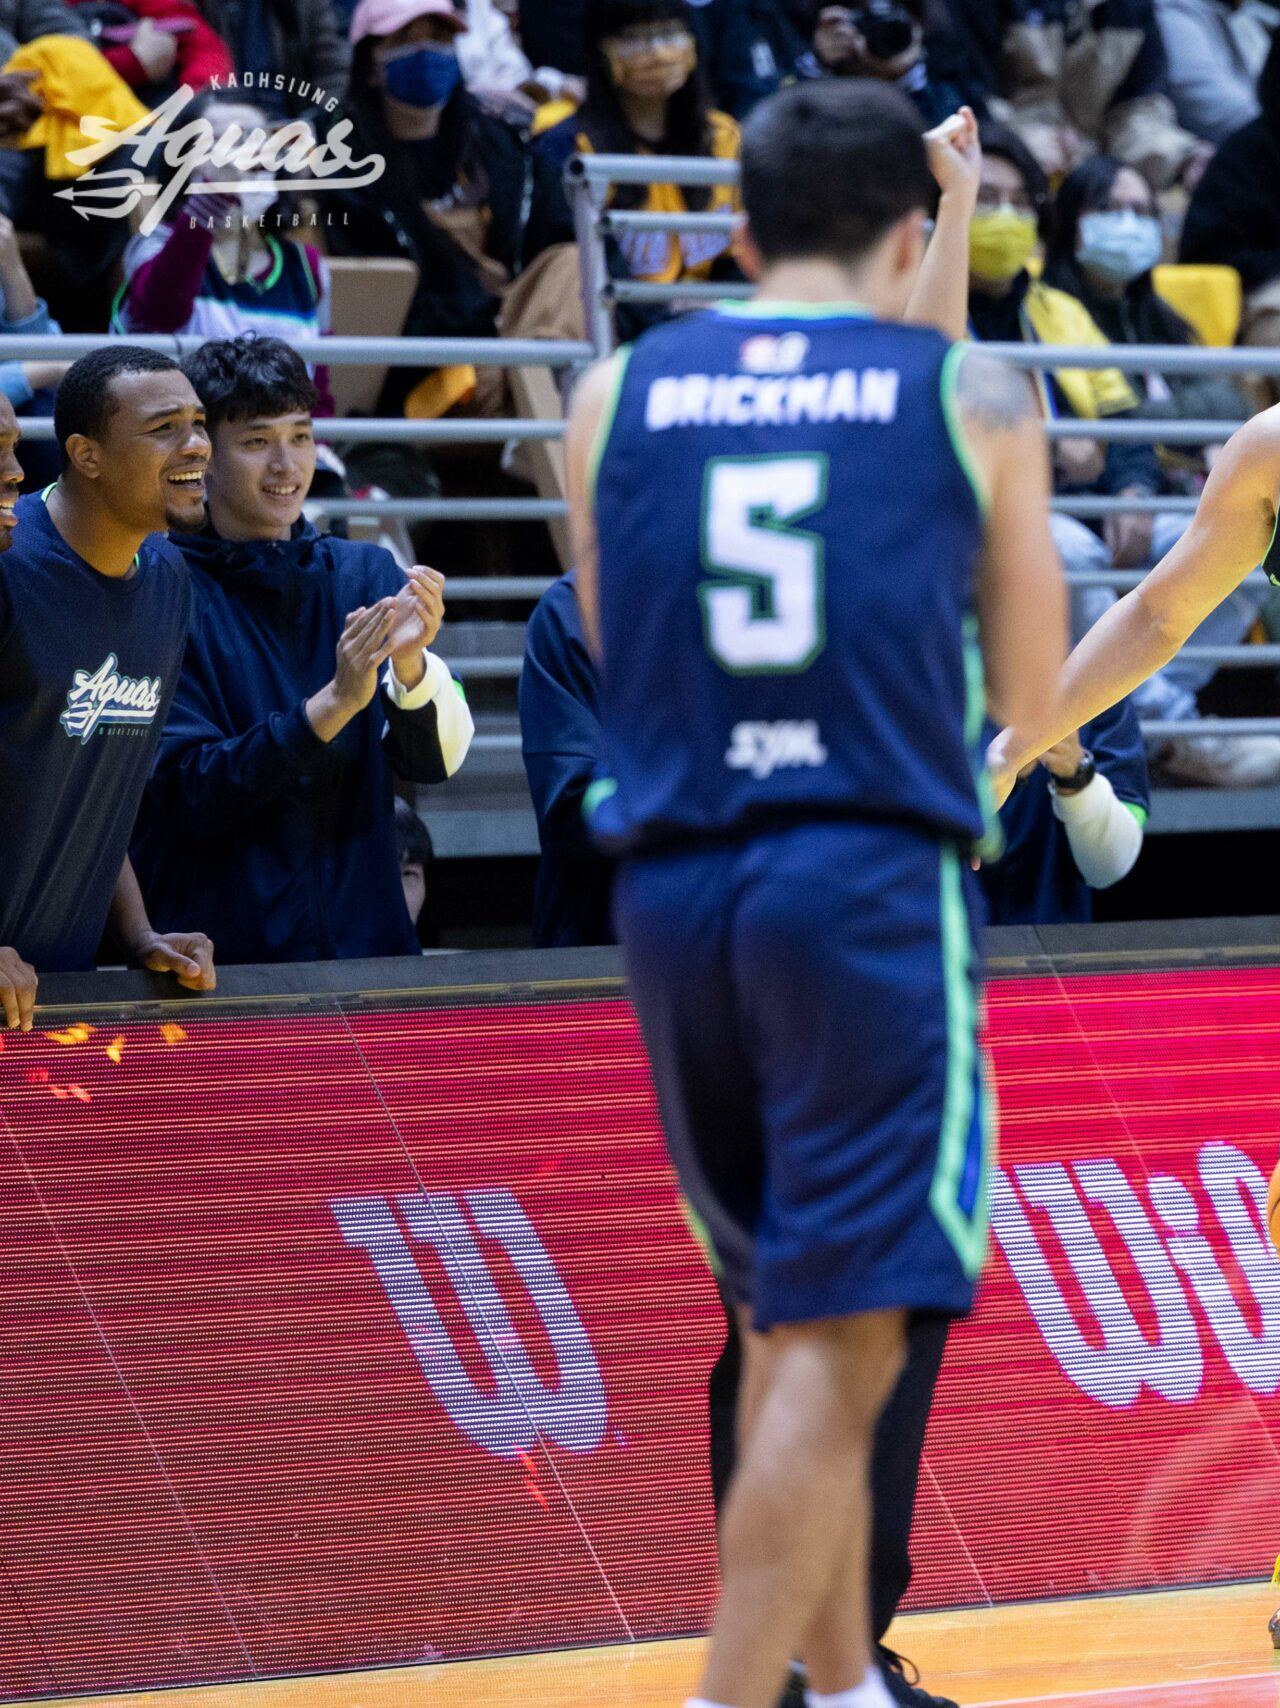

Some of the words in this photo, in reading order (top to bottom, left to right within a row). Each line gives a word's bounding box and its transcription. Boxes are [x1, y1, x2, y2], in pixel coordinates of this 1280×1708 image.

[644, 368, 900, 432] BRICKMAN
[697, 450, 830, 677] 5
[69, 654, 161, 739] Aquas
